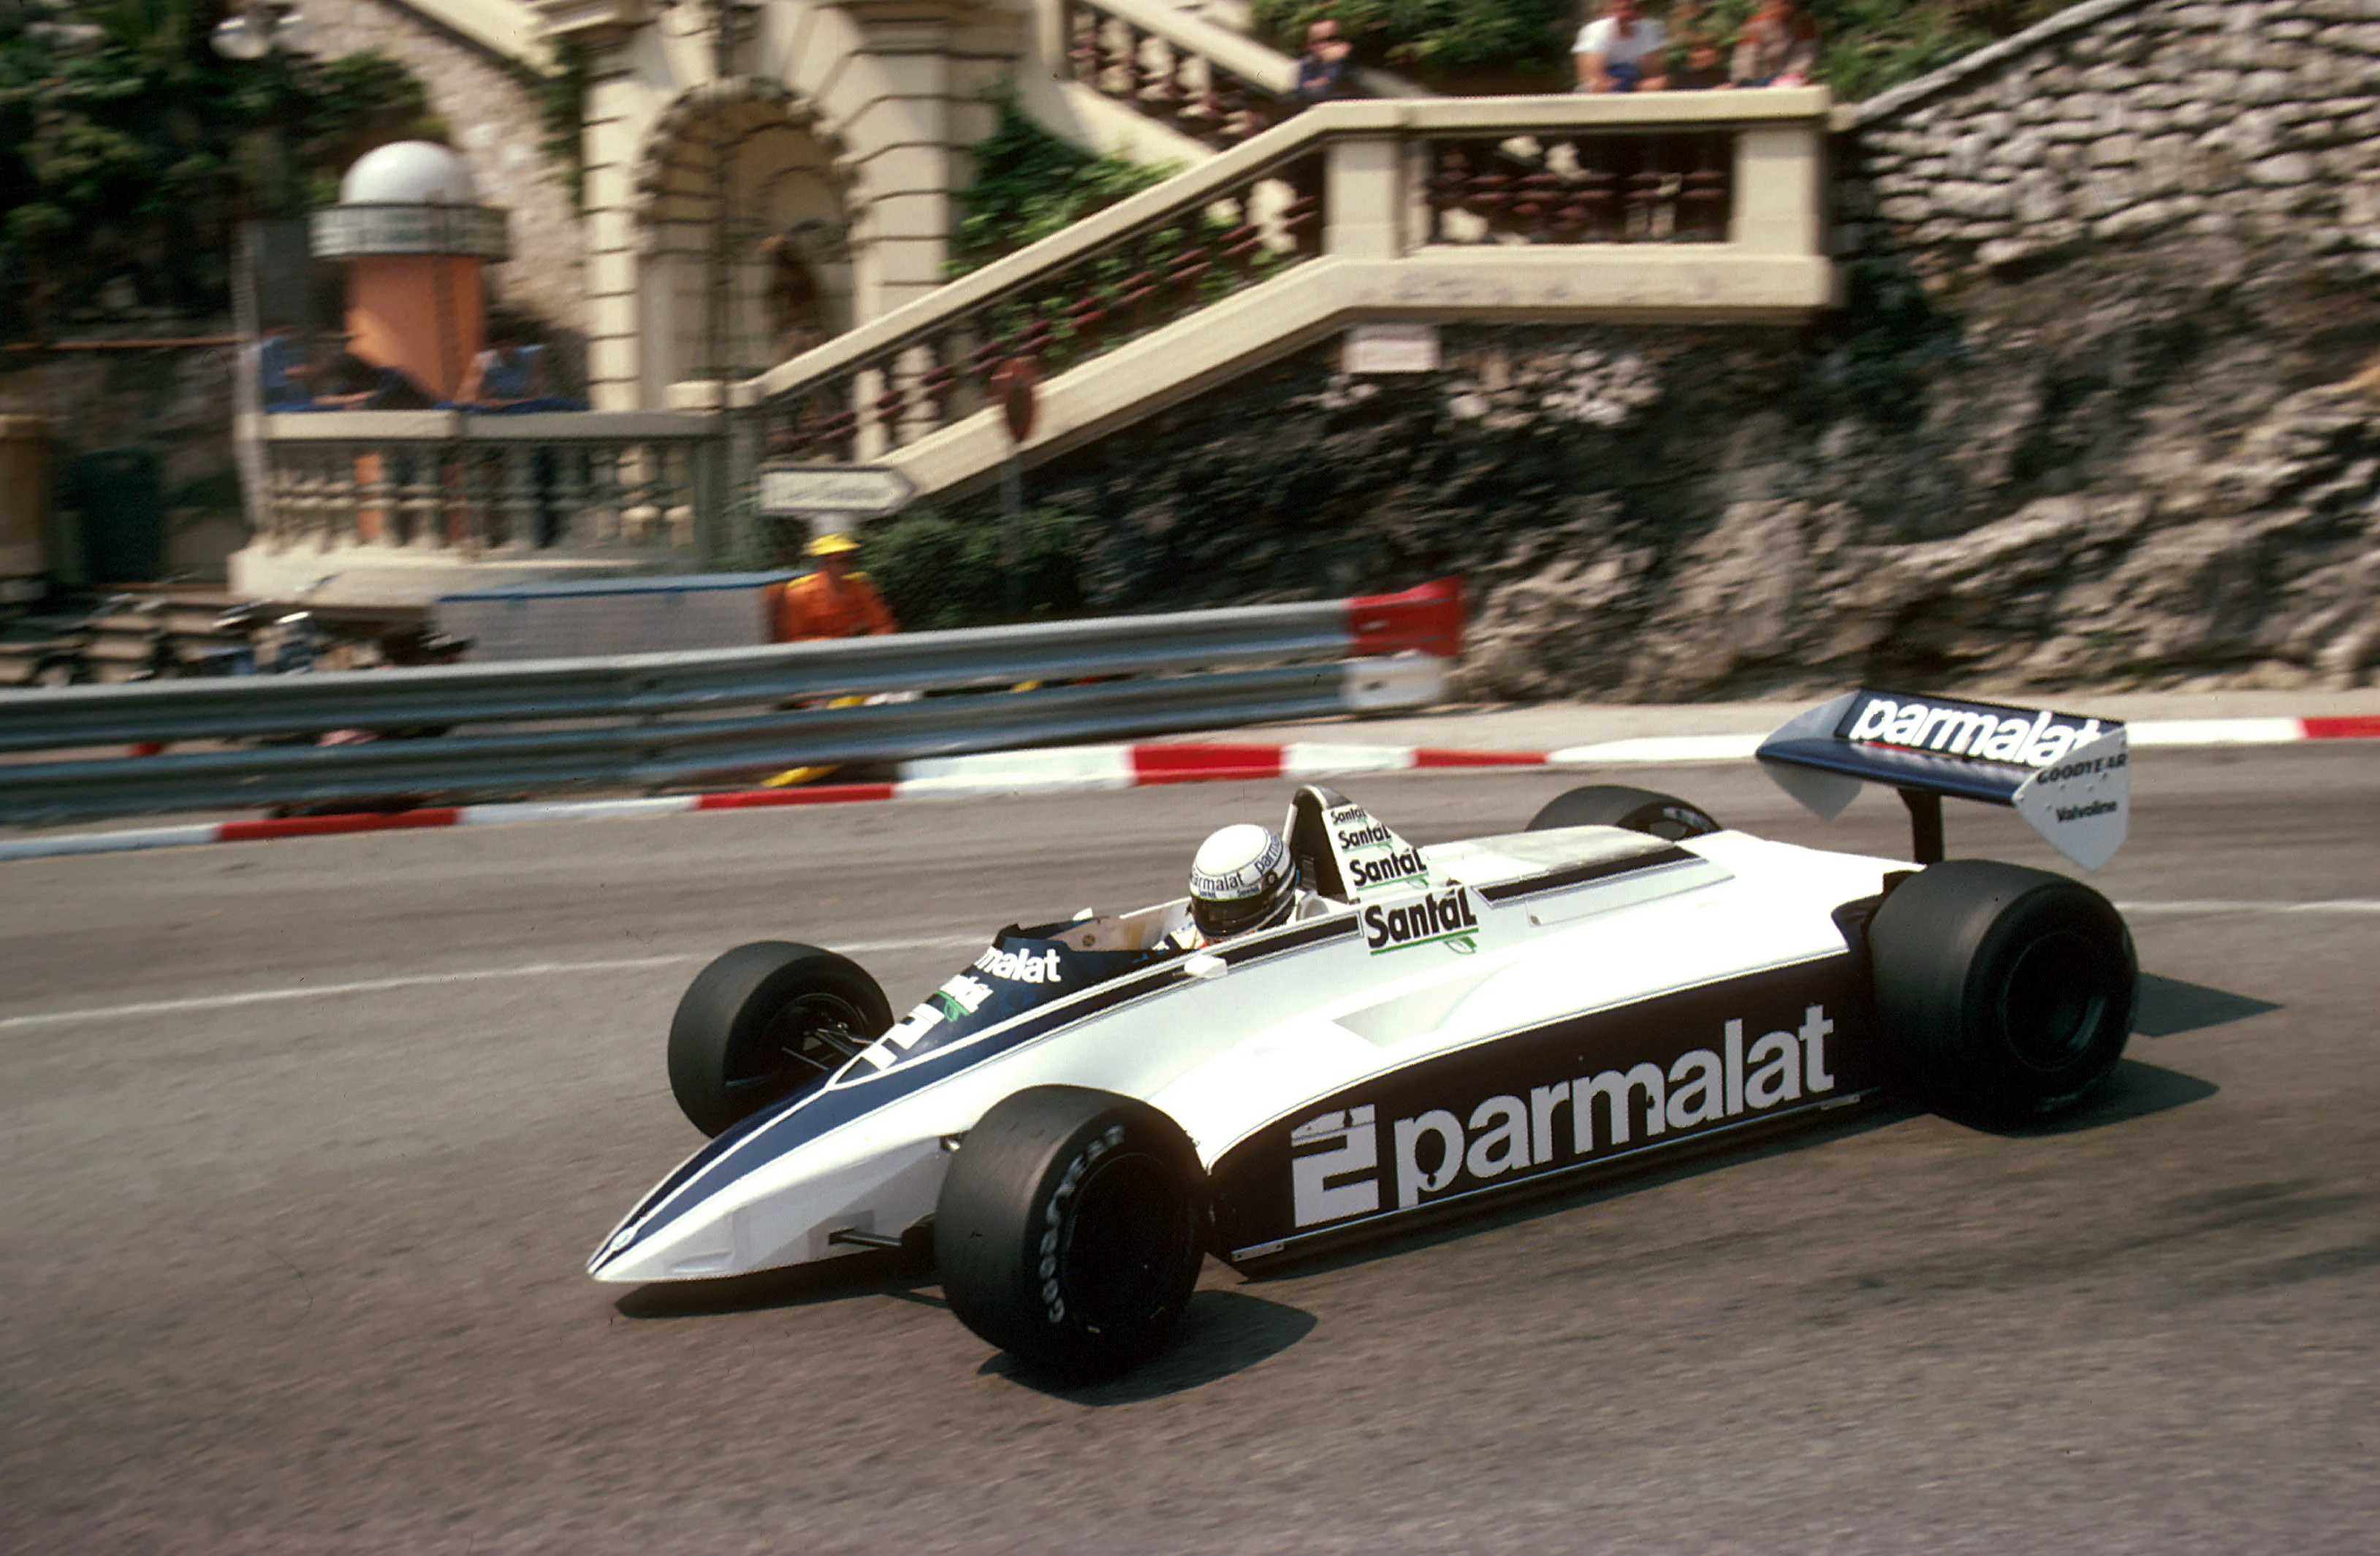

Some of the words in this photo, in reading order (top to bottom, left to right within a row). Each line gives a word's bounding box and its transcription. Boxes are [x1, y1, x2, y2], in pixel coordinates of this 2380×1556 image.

[1849, 697, 2102, 767] parmalat
[2037, 753, 2128, 784] GOODYEAR
[2056, 799, 2118, 823] Valvoline
[1394, 1004, 1835, 1210] parmalat
[1290, 1103, 1380, 1228] 2
